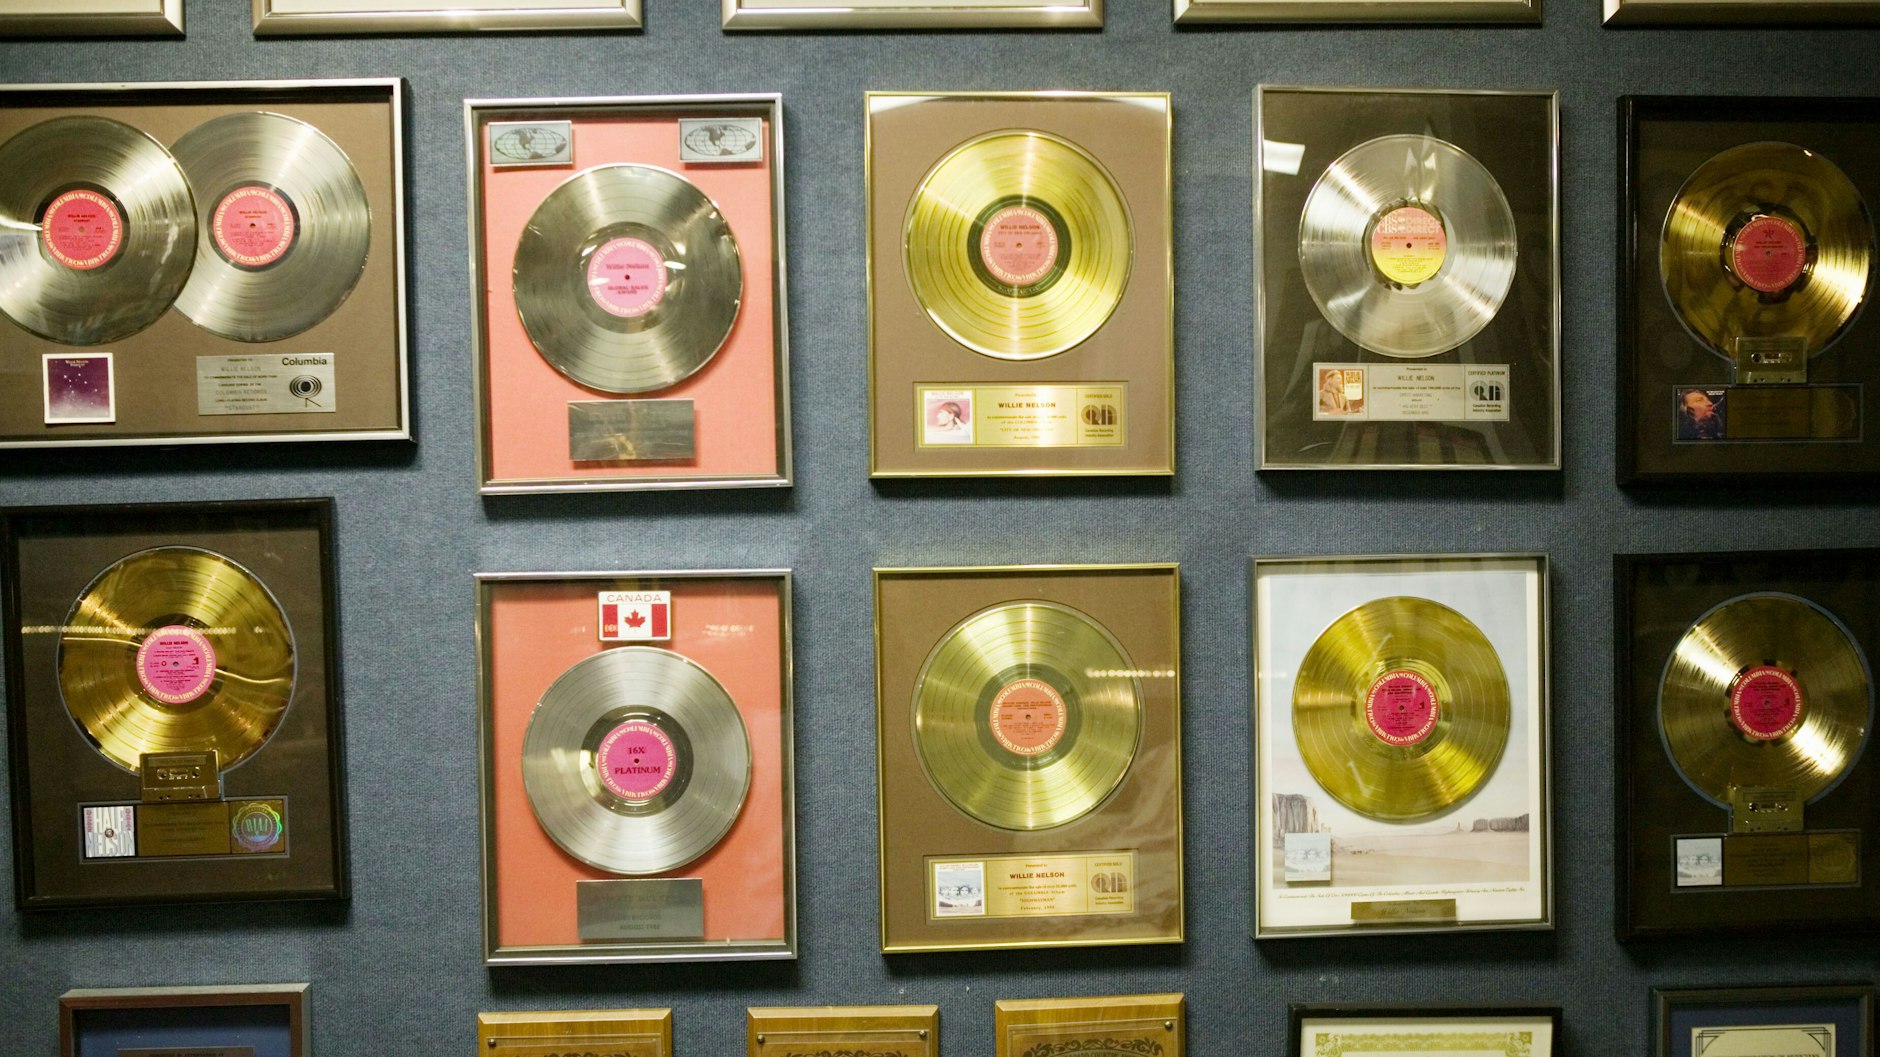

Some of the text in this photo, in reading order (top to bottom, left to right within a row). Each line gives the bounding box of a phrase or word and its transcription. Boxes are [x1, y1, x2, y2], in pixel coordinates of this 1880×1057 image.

[282, 357, 327, 366] Columbia
[606, 594, 662, 602] CANADA
[614, 766, 661, 774] PLATINUM
